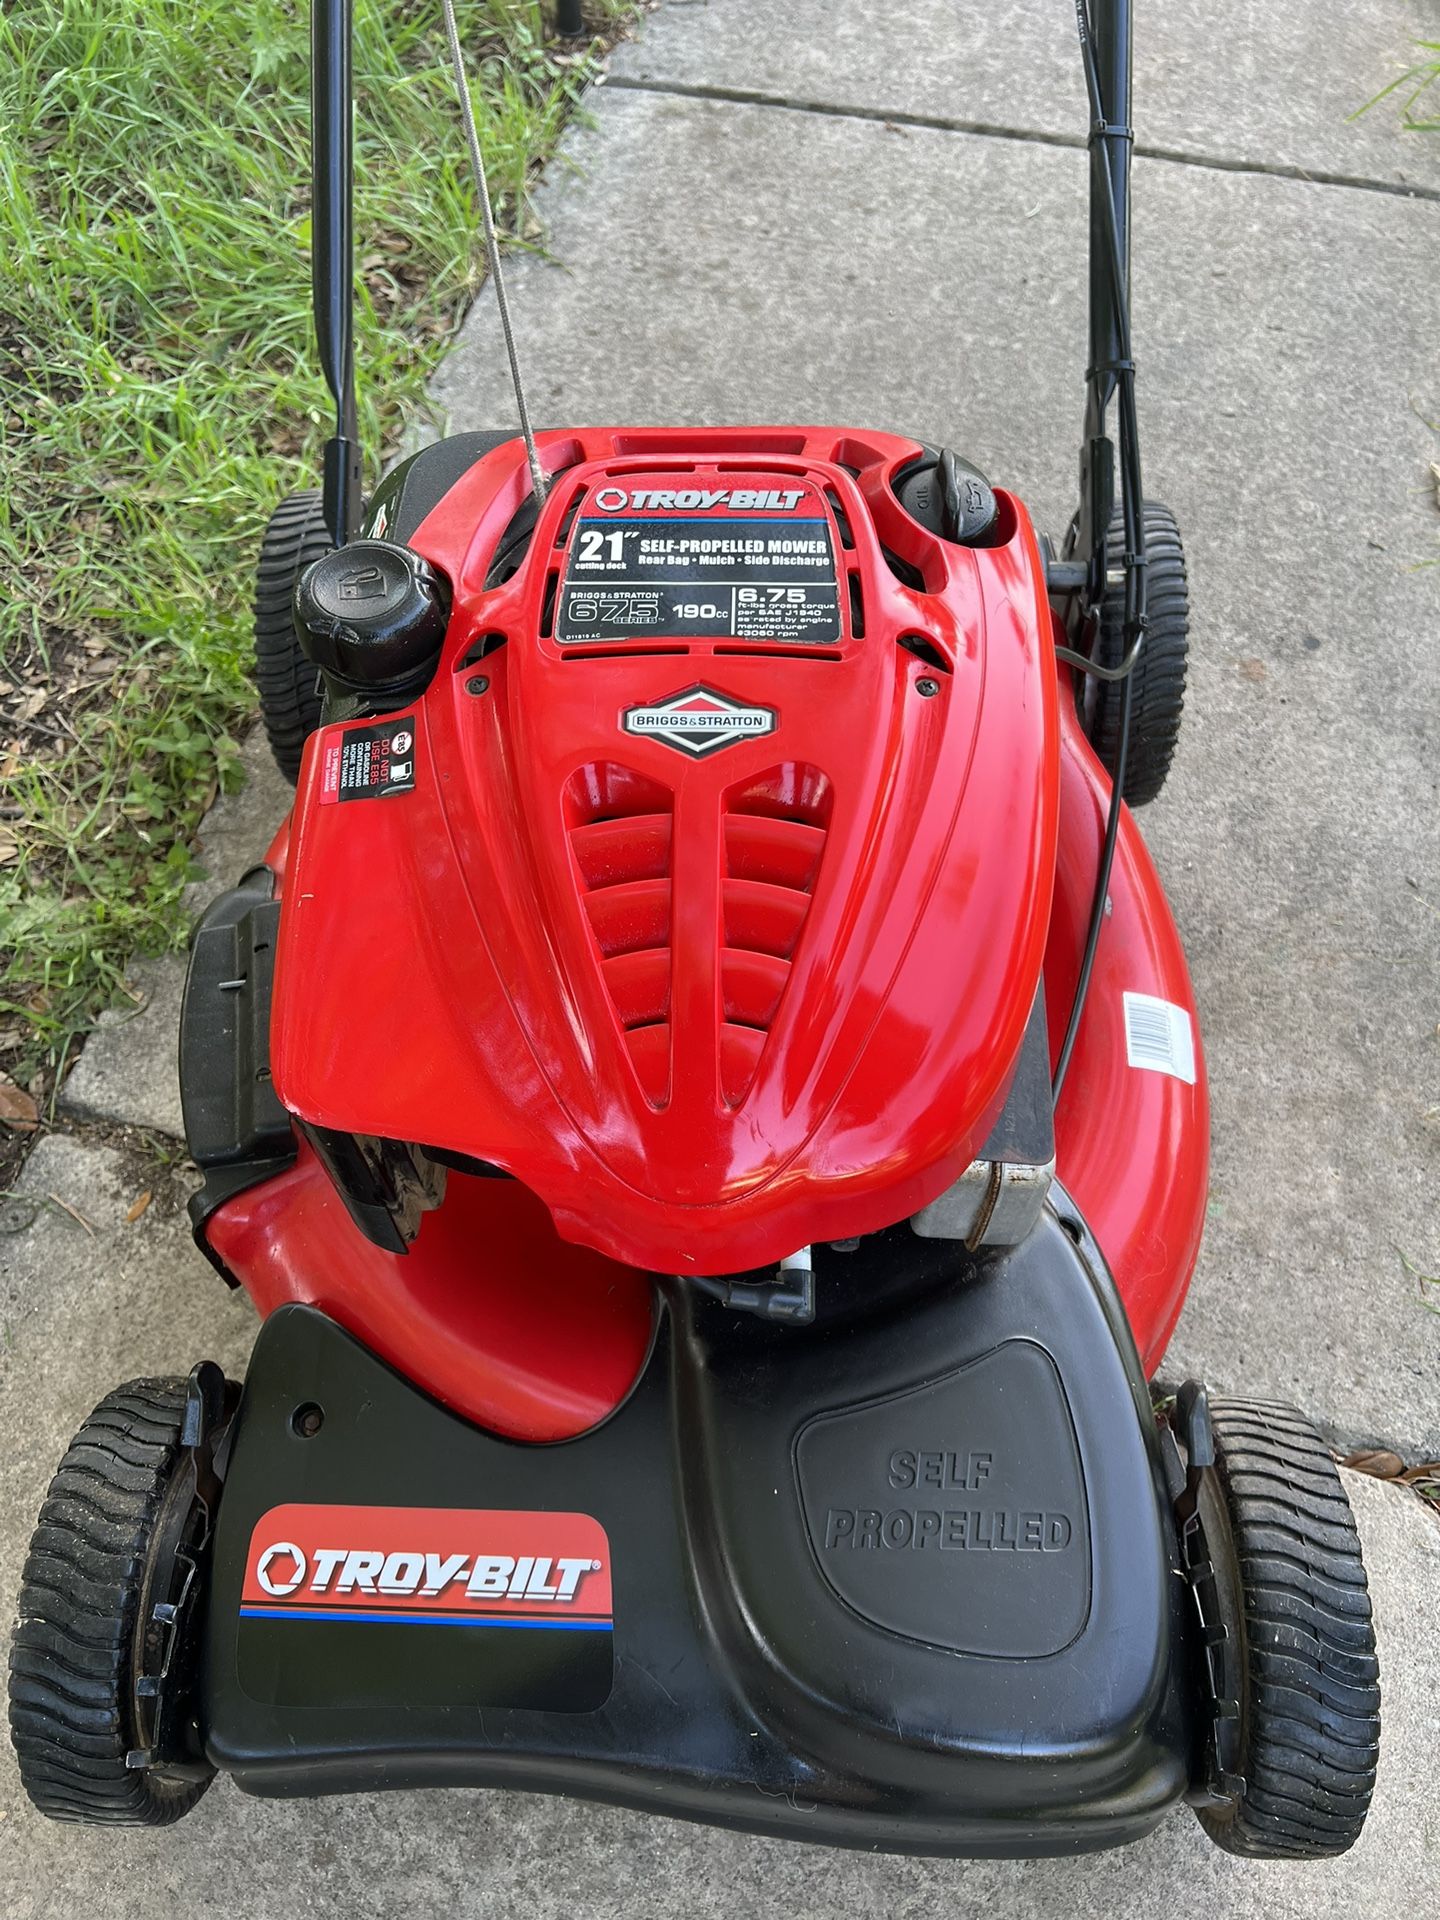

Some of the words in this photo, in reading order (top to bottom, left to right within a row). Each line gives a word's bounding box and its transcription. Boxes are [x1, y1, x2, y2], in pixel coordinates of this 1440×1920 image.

[630, 490, 805, 511] TROY-BILT
[640, 539, 765, 553] SELF-PROPELLED
[767, 540, 828, 554] MOWER
[574, 562, 606, 571] cutting
[606, 561, 627, 570] deck
[638, 555, 666, 565] Rear
[667, 555, 690, 568] Bag
[699, 555, 736, 566] Mulch
[744, 555, 770, 566] Side
[772, 555, 830, 567] Discharge
[737, 587, 807, 603] 6.75
[568, 599, 659, 622] 675
[672, 603, 729, 619] 190cc
[737, 609, 756, 617] per
[768, 602, 799, 611] gross
[801, 603, 836, 612] torque
[613, 616, 658, 624] SERIES
[752, 615, 782, 623] rated
[784, 616, 797, 624] by
[799, 617, 833, 625] engine
[636, 716, 763, 727] BRIGGS&STRATTON
[332, 747, 340, 757] TO
[349, 743, 357, 765] MORE
[364, 741, 371, 752] OR
[371, 740, 381, 762] USE
[381, 739, 390, 755] DO
[330, 757, 339, 791] PREVENT
[341, 759, 349, 789] ETHANOL
[356, 742, 364, 788] CONTAINING
[362, 752, 371, 786] GASOLINE
[369, 764, 380, 786] E85
[380, 759, 390, 783] NOT
[348, 766, 356, 788] THAN
[888, 1451, 993, 1491] SELF
[825, 1509, 1072, 1552] PROPELLED
[309, 1548, 593, 1601] TROY-BILT
